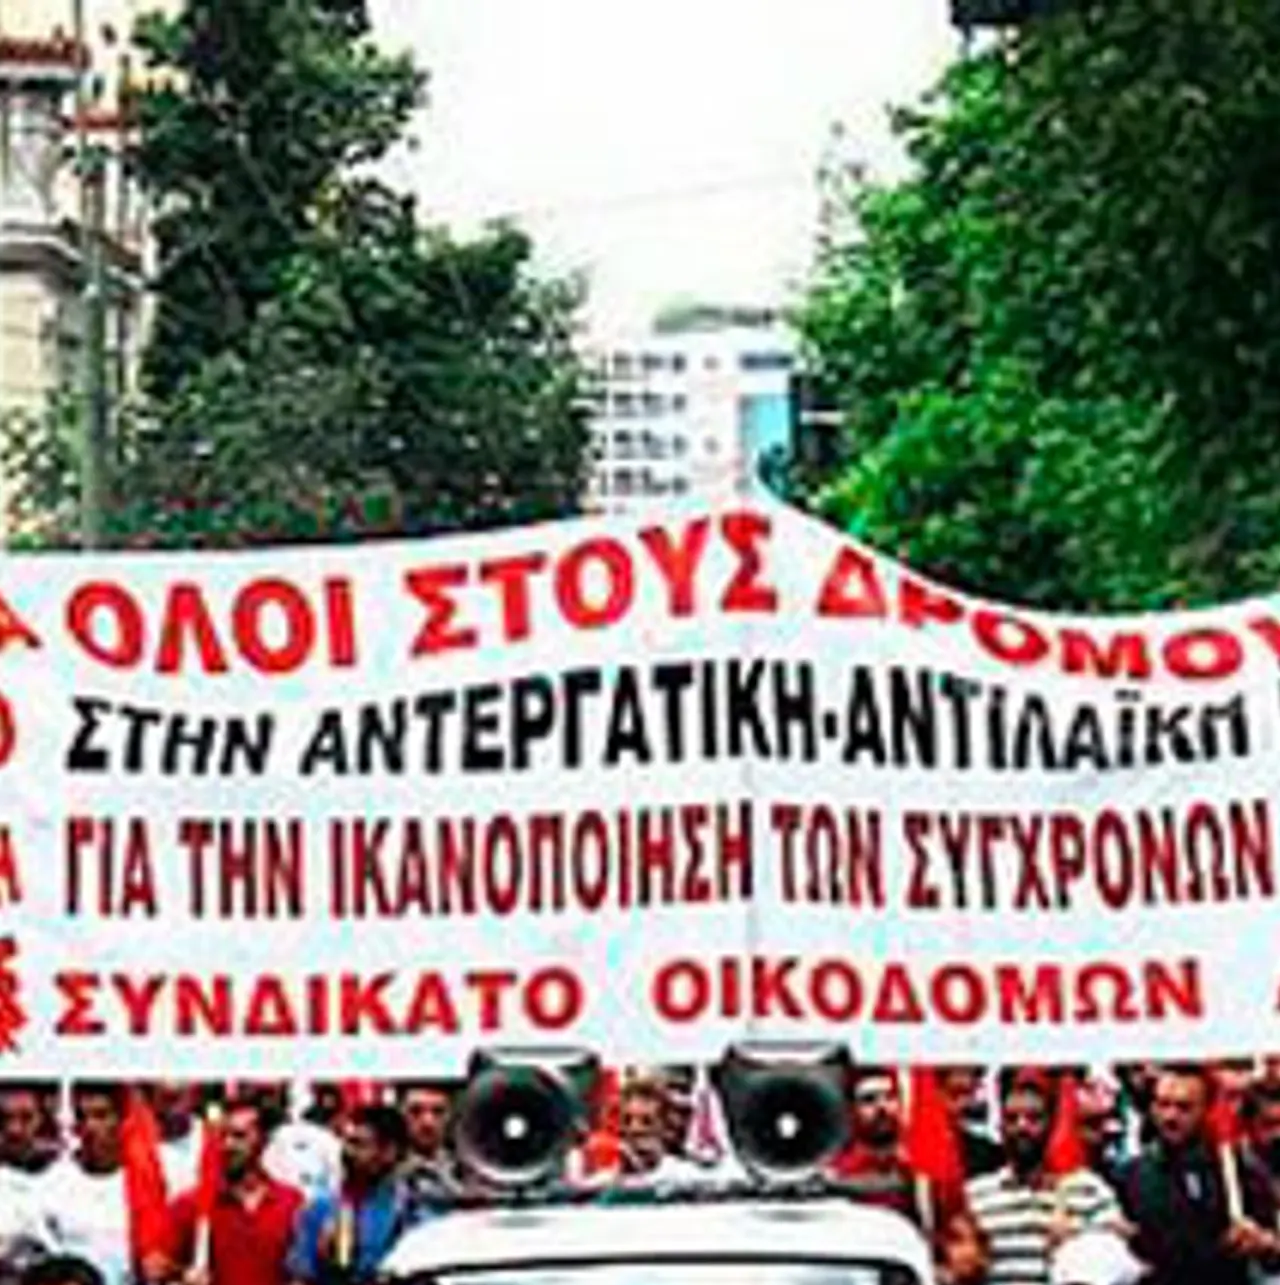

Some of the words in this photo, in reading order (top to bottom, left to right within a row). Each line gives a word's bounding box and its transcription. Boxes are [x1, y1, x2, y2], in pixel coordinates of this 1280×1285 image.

[64, 577, 356, 676] ΟΛΟΙ
[404, 510, 776, 658] ΣΤΟΥΣ
[65, 697, 277, 775] ΣΤΗΝ
[65, 815, 159, 920] ΓΙΑ
[178, 815, 303, 920] ΤΗΝ
[329, 804, 756, 918] ΙΚΑΝΟΠΟΙΗΣΗ
[770, 804, 888, 907] ΤΩΝ
[903, 798, 1275, 910] ΣΥΓΧΡΟΝΩΝ
[53, 966, 584, 1036] ΣΥΝΔΙΚΑΤΟ
[652, 955, 1206, 1026] ΟΙΚΟΔΟΜΩΝ
